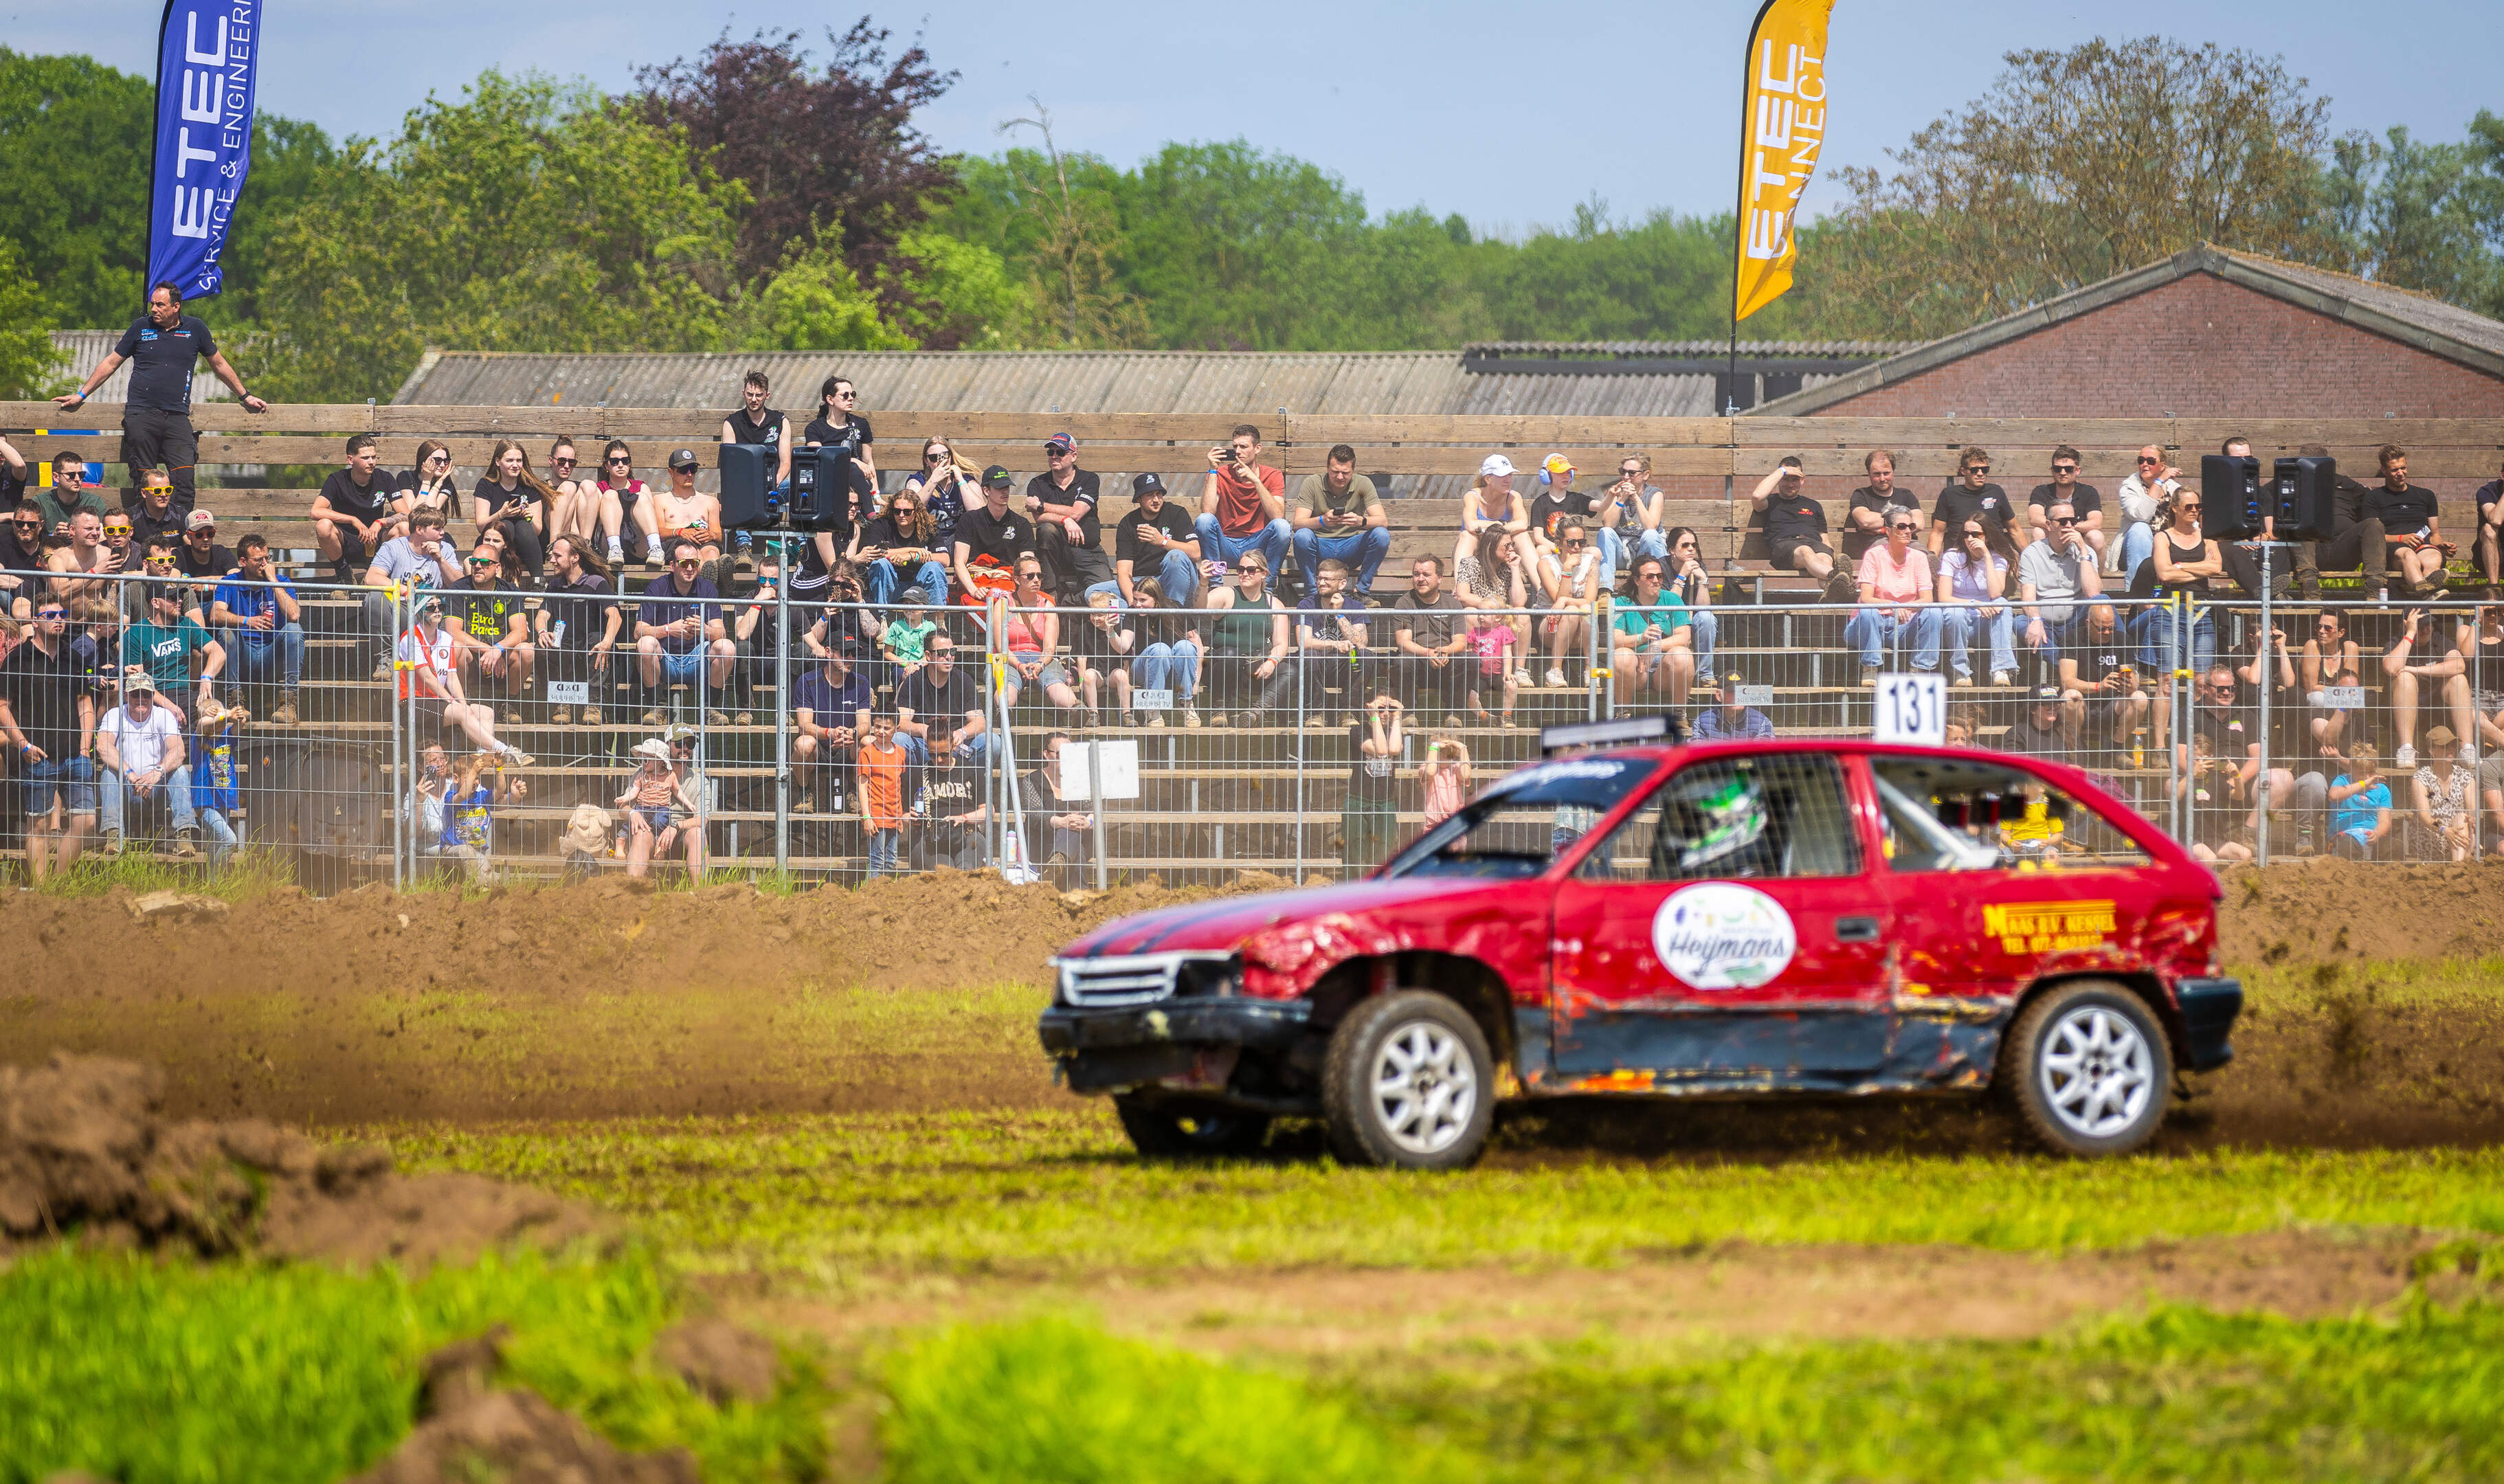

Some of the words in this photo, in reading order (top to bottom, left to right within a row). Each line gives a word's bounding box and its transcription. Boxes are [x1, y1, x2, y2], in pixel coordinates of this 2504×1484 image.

[172, 11, 227, 238] ETEC
[1748, 38, 1797, 259] ETEC
[199, 188, 234, 290] SERVICE
[221, 160, 236, 178] &
[471, 612, 495, 625] Euro
[471, 624, 500, 635] Parcs
[151, 638, 181, 657] VANS
[2099, 655, 2118, 665] 901
[1889, 679, 1938, 734] 131
